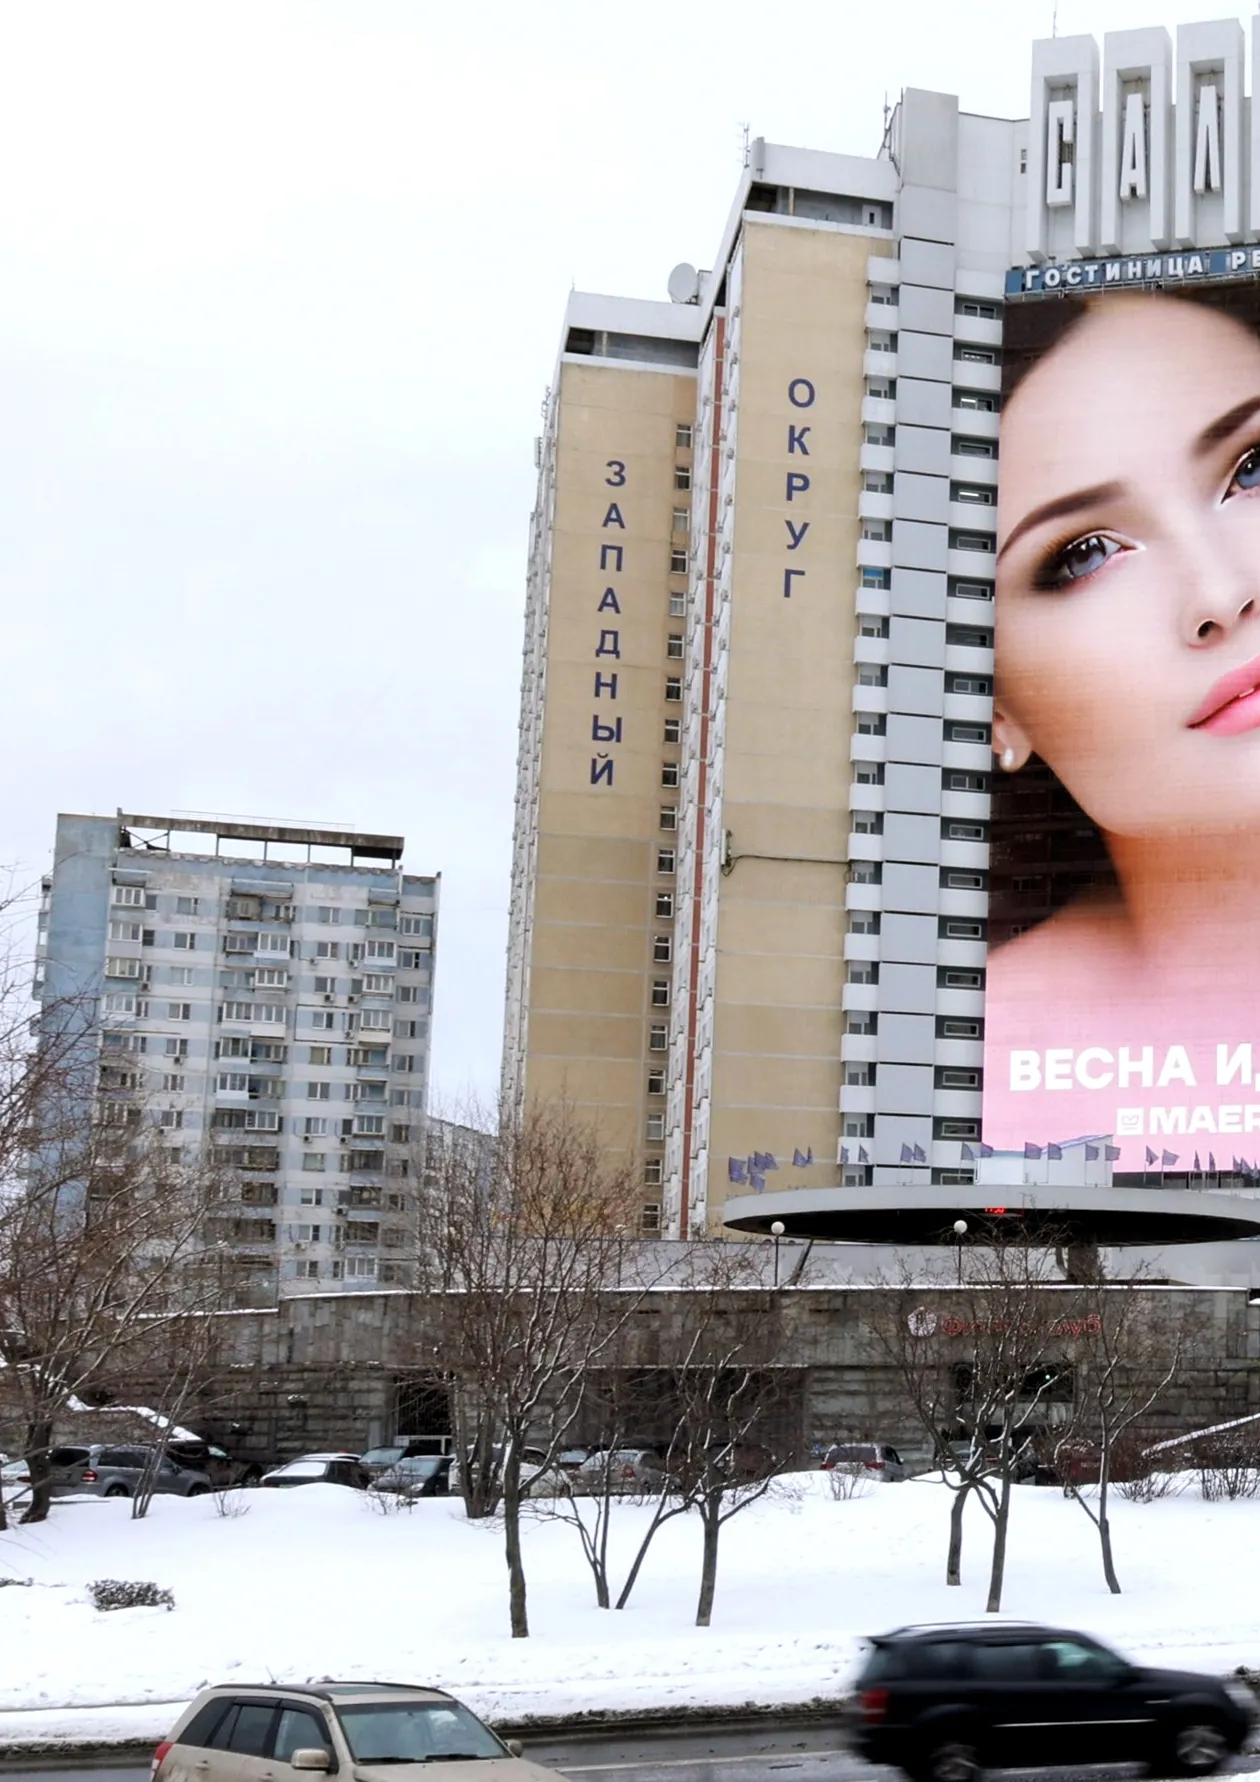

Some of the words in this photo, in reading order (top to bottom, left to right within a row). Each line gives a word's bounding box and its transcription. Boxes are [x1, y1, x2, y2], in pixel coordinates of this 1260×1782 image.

[1024, 254, 1204, 289] ГОСТИНИЦА
[783, 377, 816, 599] ОКРУГ
[589, 459, 627, 787] ЗАПАДНЫЙ
[1009, 1045, 1197, 1092] ВЕСНА
